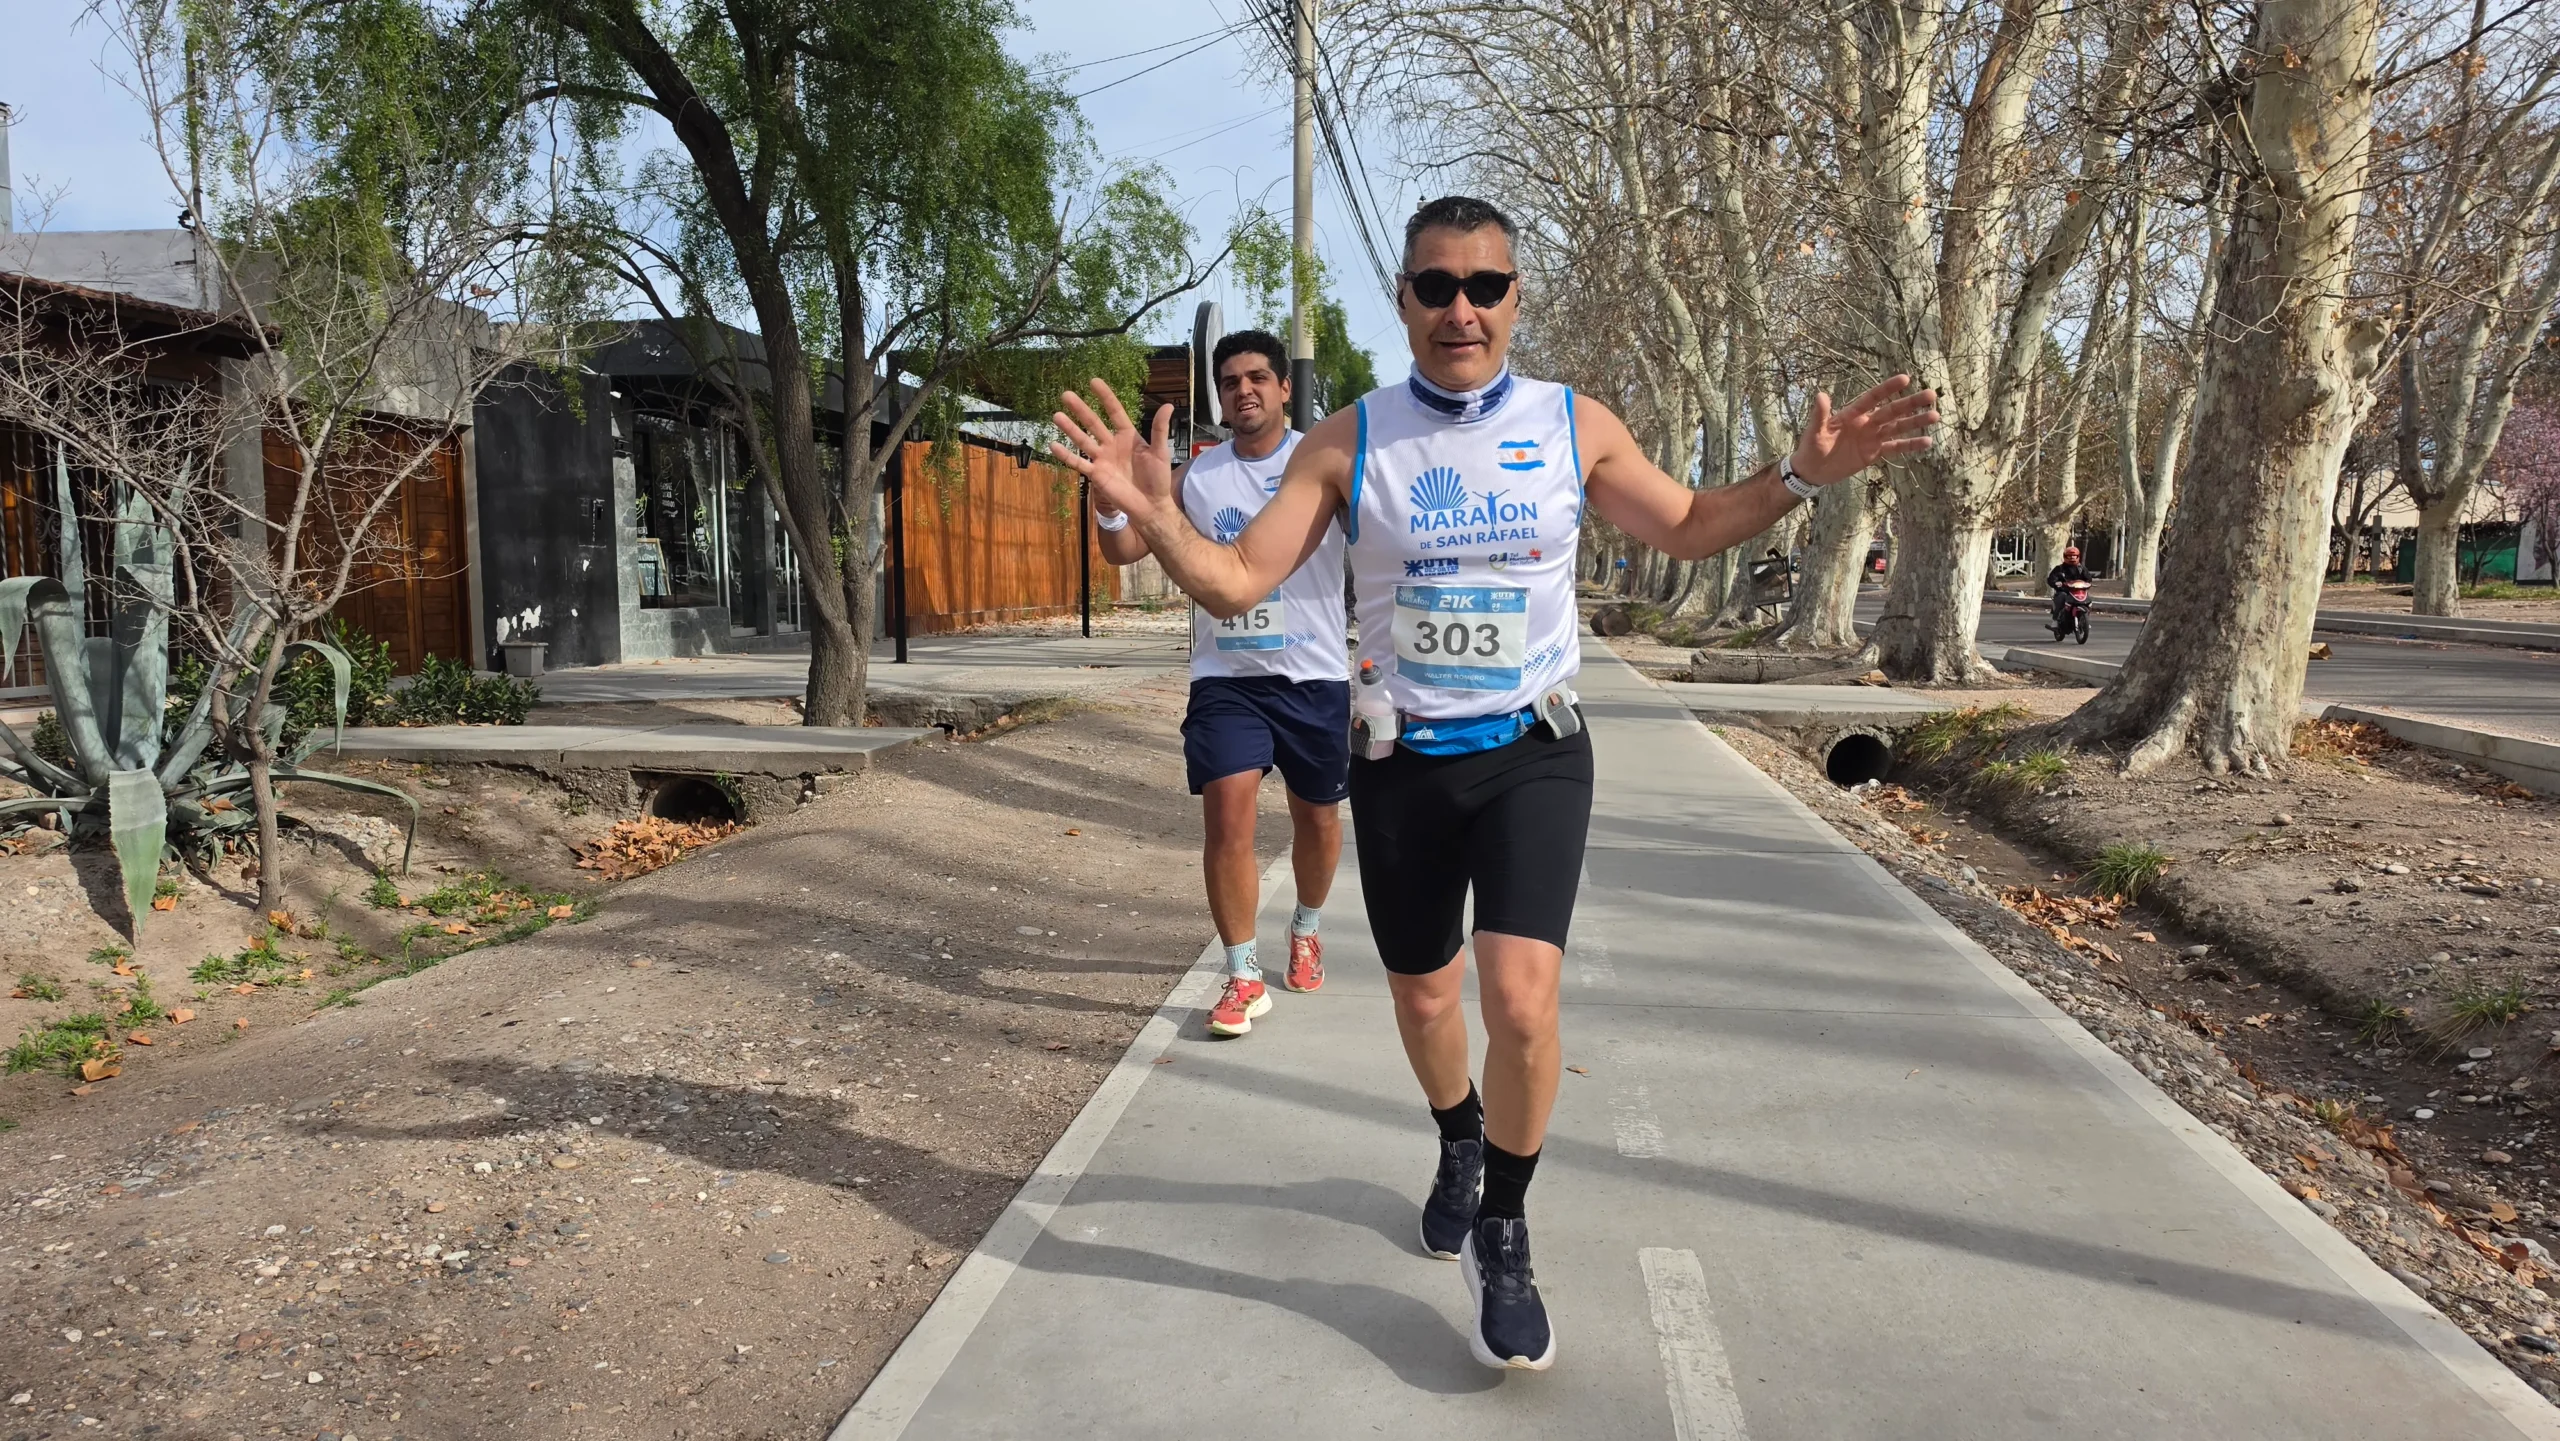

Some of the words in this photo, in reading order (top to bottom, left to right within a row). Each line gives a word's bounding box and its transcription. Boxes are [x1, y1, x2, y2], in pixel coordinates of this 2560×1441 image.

[1420, 541, 1432, 550] DE
[1436, 533, 1471, 548] SAN
[1476, 527, 1539, 544] RAFAEL
[1423, 557, 1459, 568] UTN
[1438, 594, 1476, 609] 21K
[1221, 608, 1270, 631] 415
[1413, 620, 1500, 657] 303
[1424, 672, 1452, 680] WALTER
